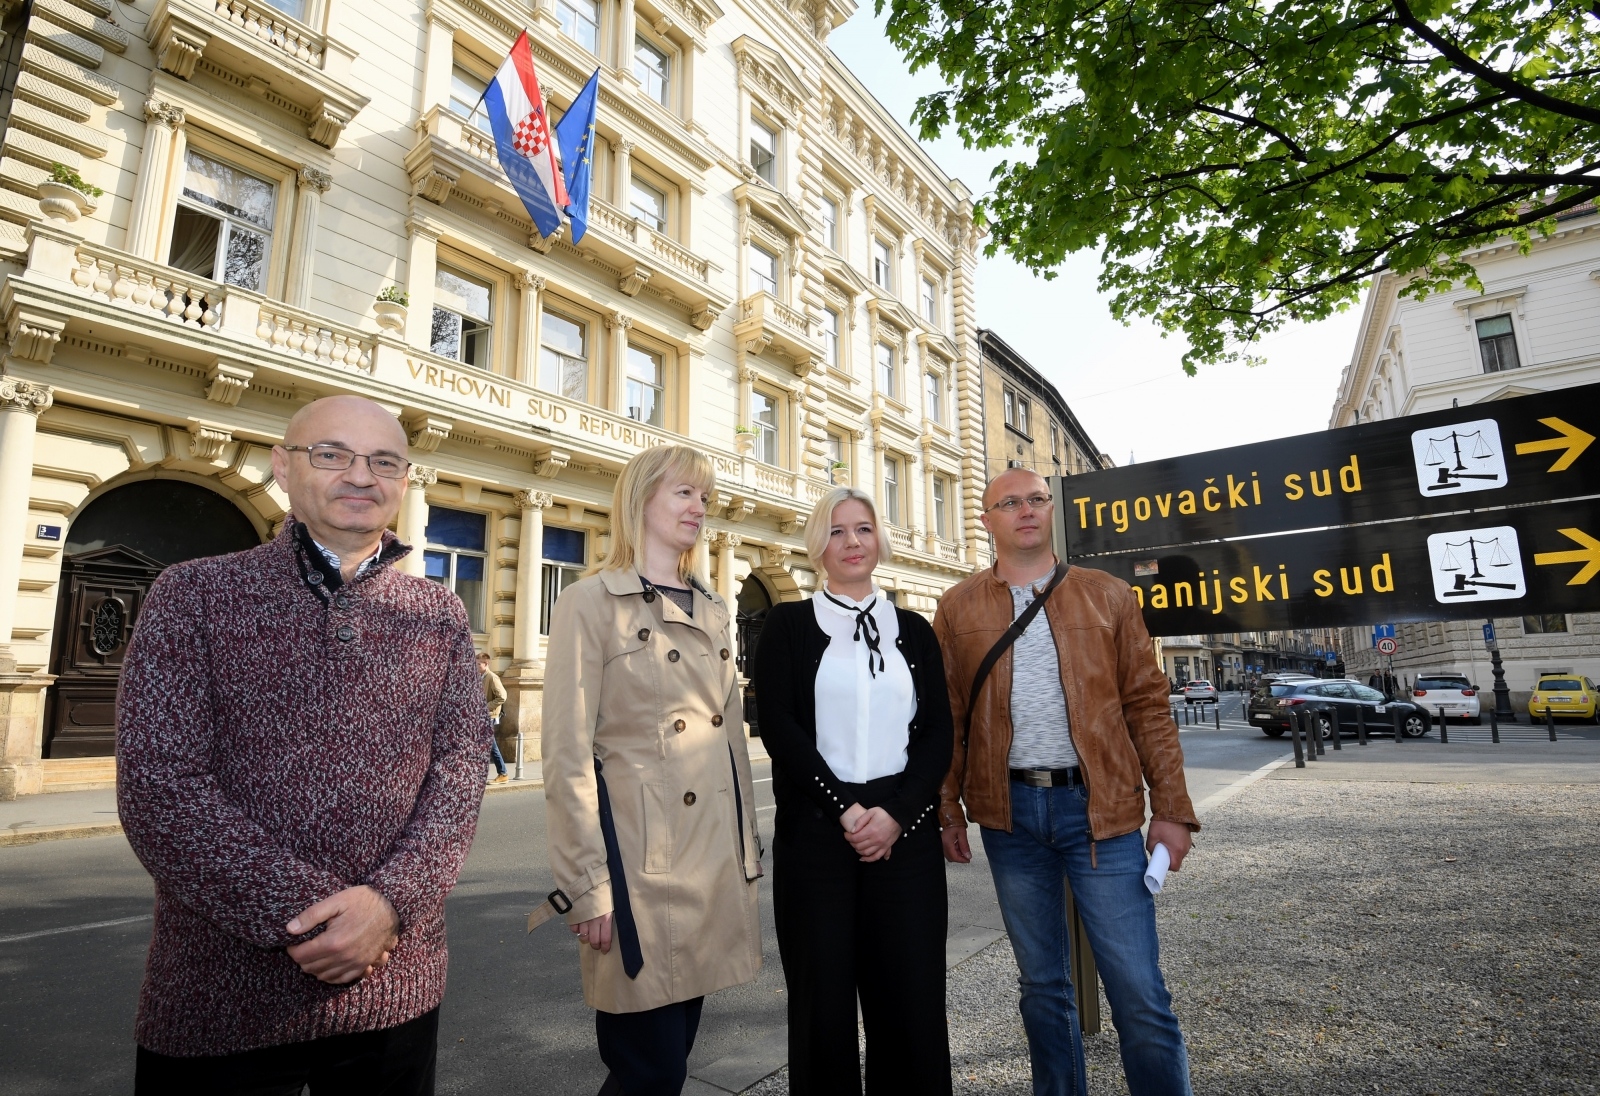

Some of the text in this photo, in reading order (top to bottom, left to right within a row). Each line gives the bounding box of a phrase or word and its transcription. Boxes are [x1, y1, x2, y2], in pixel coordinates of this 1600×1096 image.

[406, 358, 511, 409] VRHOVNI
[527, 399, 568, 425] SUD
[1073, 454, 1362, 533] Trgovački sud
[1312, 552, 1395, 598] sud
[1381, 642, 1393, 651] 40
[1485, 627, 1491, 639] P
